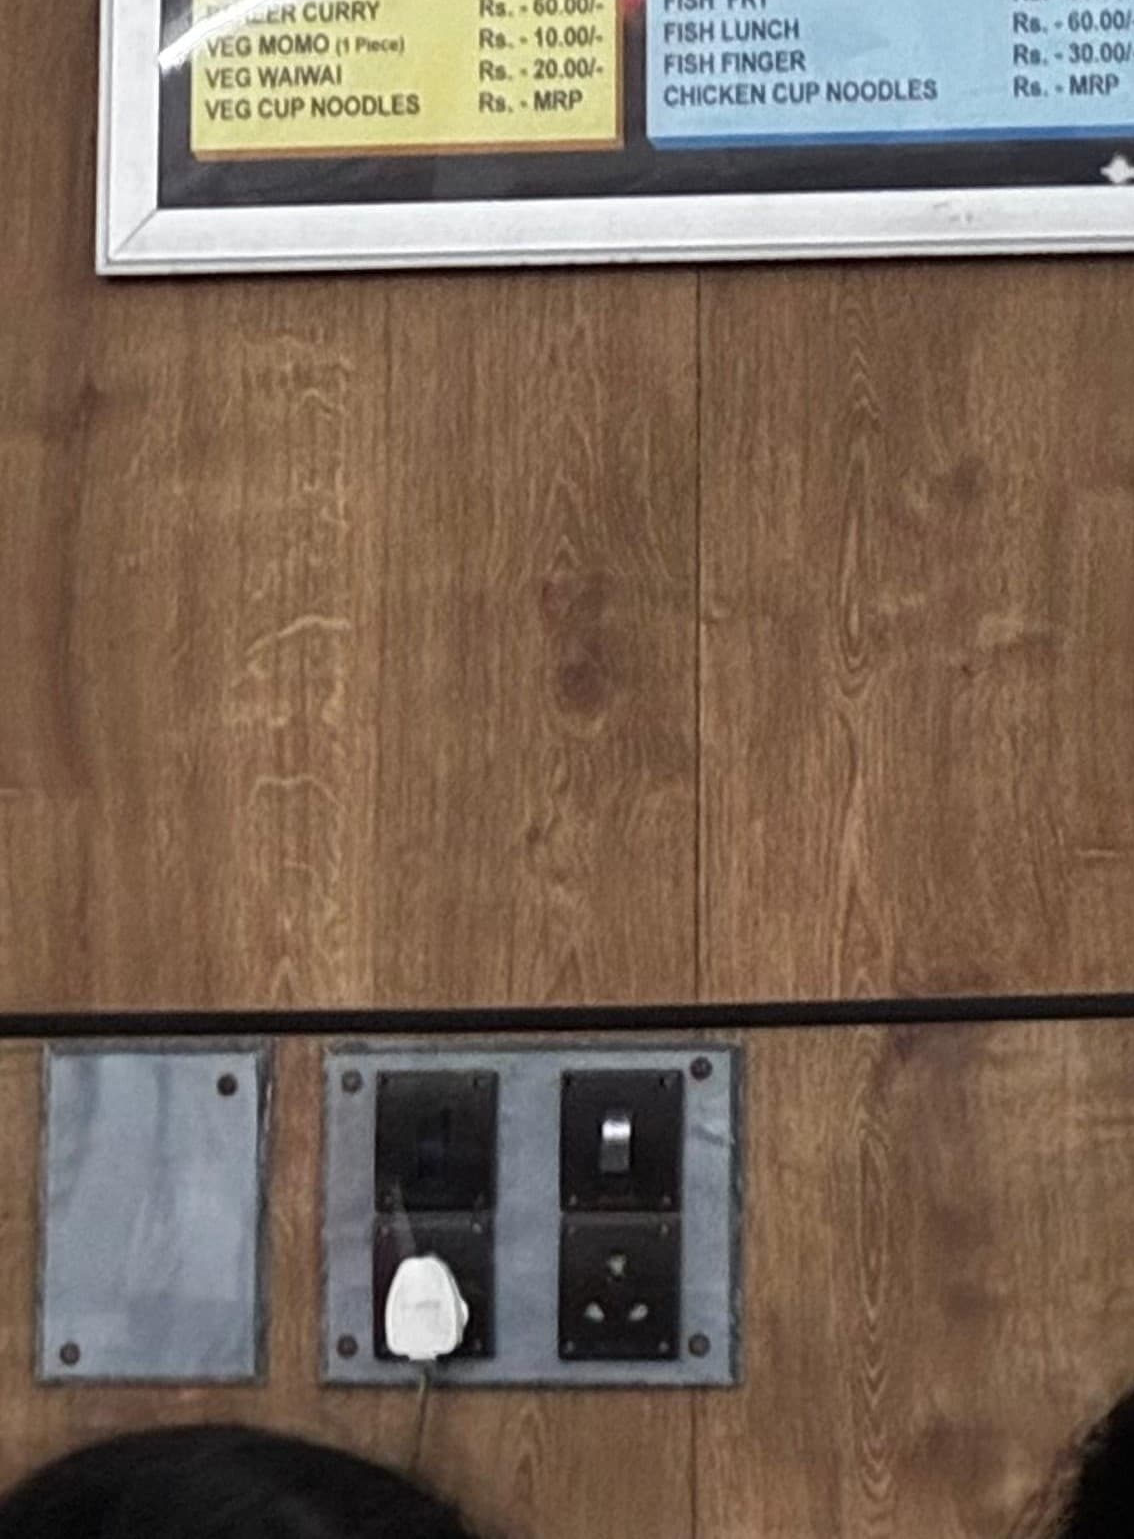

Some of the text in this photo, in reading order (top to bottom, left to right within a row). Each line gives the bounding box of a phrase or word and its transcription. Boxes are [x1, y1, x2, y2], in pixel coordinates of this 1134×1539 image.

[664, 79, 938, 106] CHICKEN CUP NOODLES
[205, 94, 420, 119] VEG CUP NOODLES
